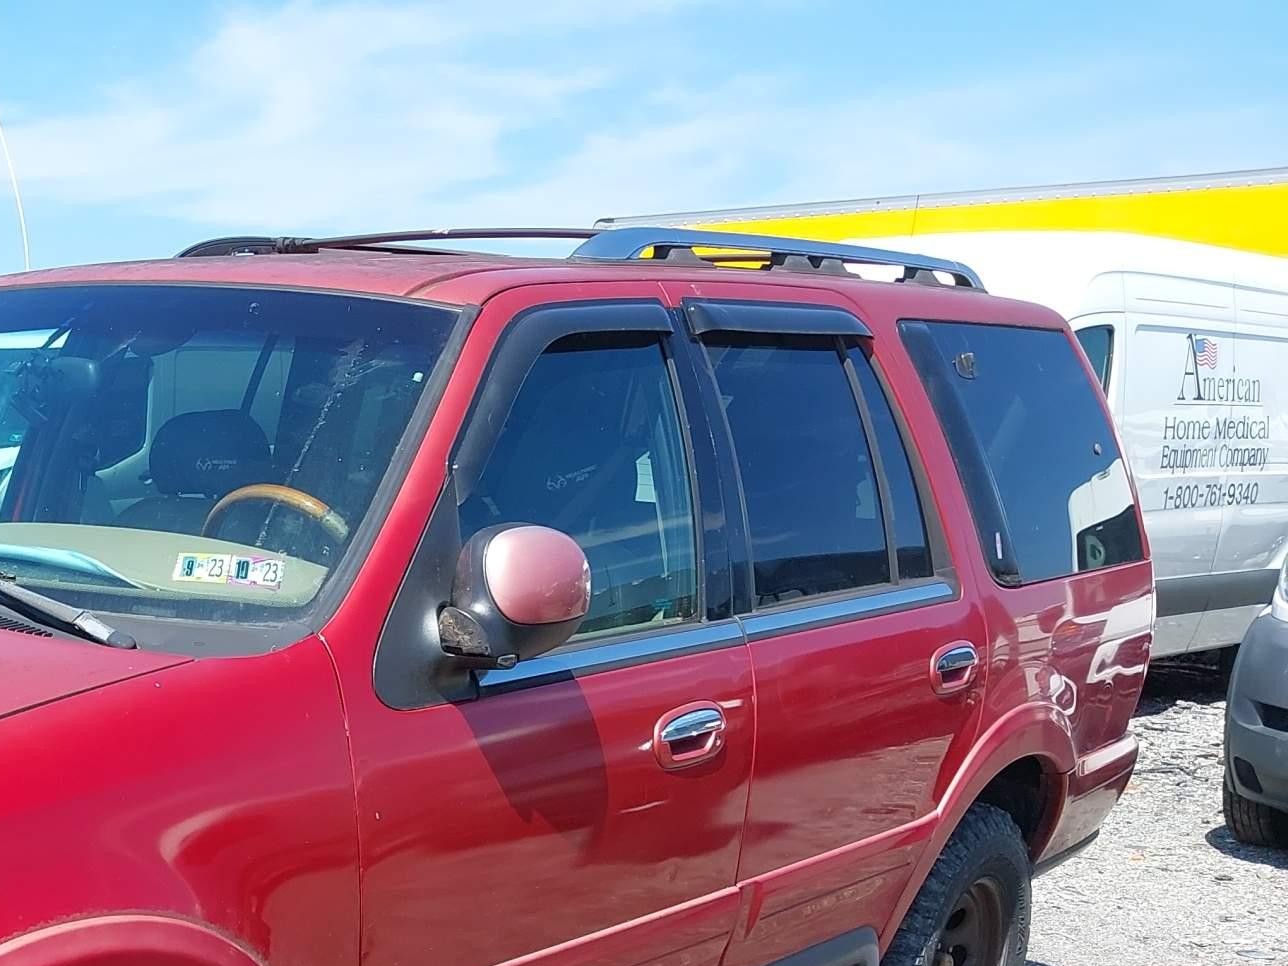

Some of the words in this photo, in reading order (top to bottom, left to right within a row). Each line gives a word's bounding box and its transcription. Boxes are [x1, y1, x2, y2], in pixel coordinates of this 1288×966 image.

[1177, 333, 1261, 403] American
[1163, 416, 1210, 440] Home
[1214, 415, 1270, 440] Medical
[1161, 445, 1216, 473] Equipment
[1218, 444, 1269, 472] Company
[1163, 482, 1259, 510] 1-800-761-9340
[208, 558, 224, 577] 23
[235, 560, 250, 579] 10
[263, 562, 279, 582] 23
